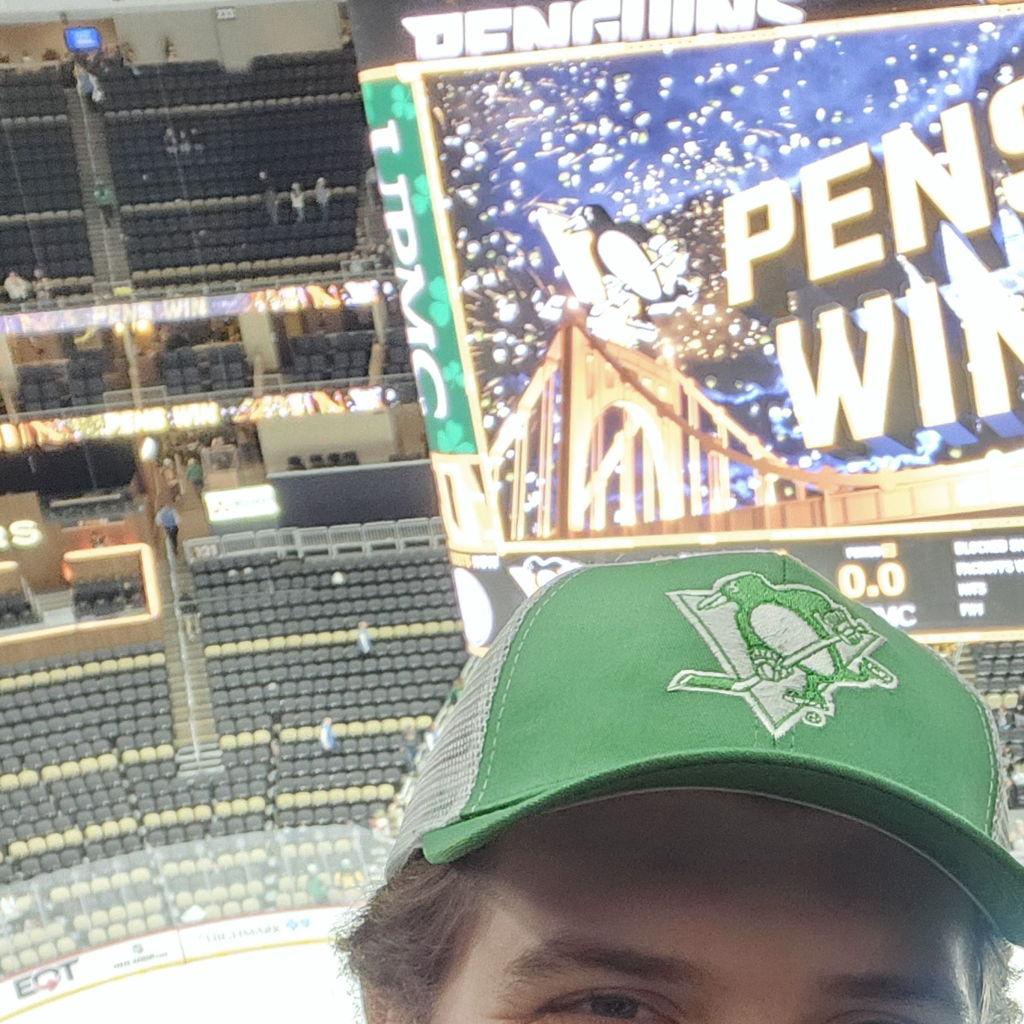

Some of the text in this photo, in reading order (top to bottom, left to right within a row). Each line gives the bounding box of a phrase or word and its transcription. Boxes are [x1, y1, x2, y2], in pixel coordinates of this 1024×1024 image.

[0, 519, 42, 549] S
[838, 561, 906, 599] 0.0
[868, 603, 918, 627] MC
[13, 957, 79, 1000] EQT
